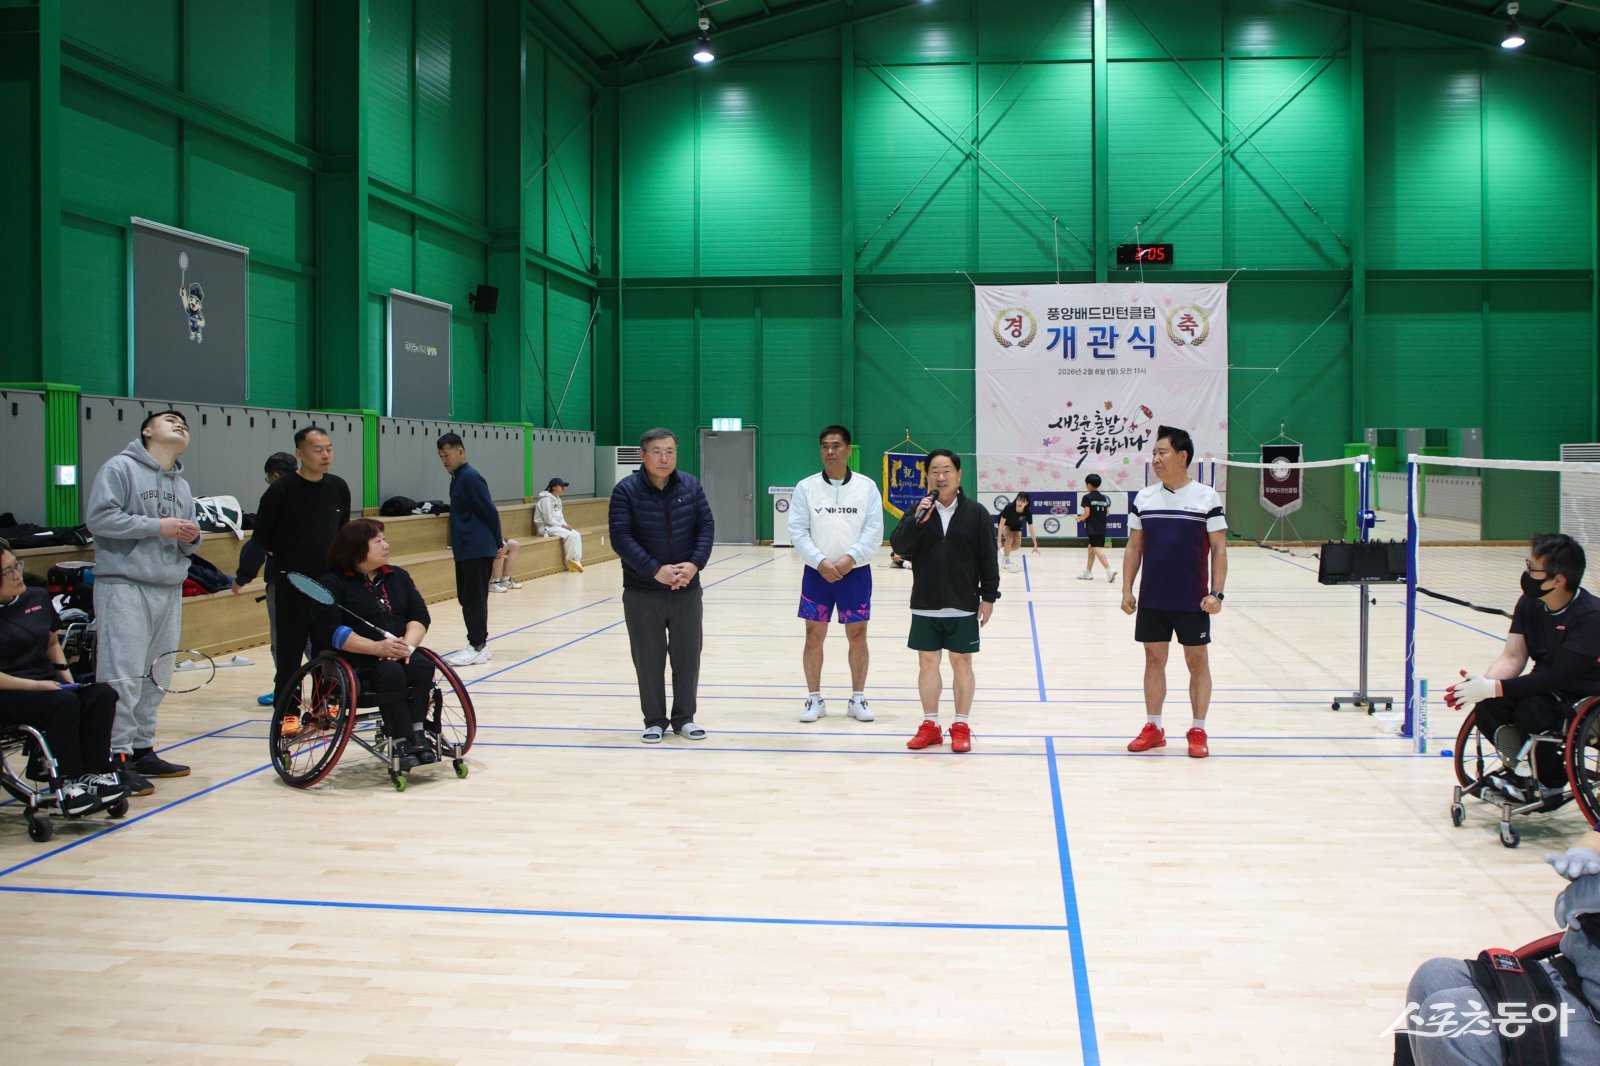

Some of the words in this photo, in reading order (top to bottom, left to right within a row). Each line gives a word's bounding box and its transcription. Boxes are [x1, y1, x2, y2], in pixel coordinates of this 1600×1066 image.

[1047, 306, 1156, 321] 풍양배드민턴클럽
[1176, 313, 1199, 337] 축
[1004, 315, 1023, 338] 경
[1058, 368, 1082, 376] 2026년
[1082, 367, 1095, 376] 2월
[1095, 367, 1106, 376] 8일
[1120, 367, 1132, 375] 오전
[1134, 367, 1147, 375] 11시
[1048, 413, 1094, 432] 새로운
[1094, 410, 1124, 435] 출발
[1075, 432, 1149, 469] 축하합니다
